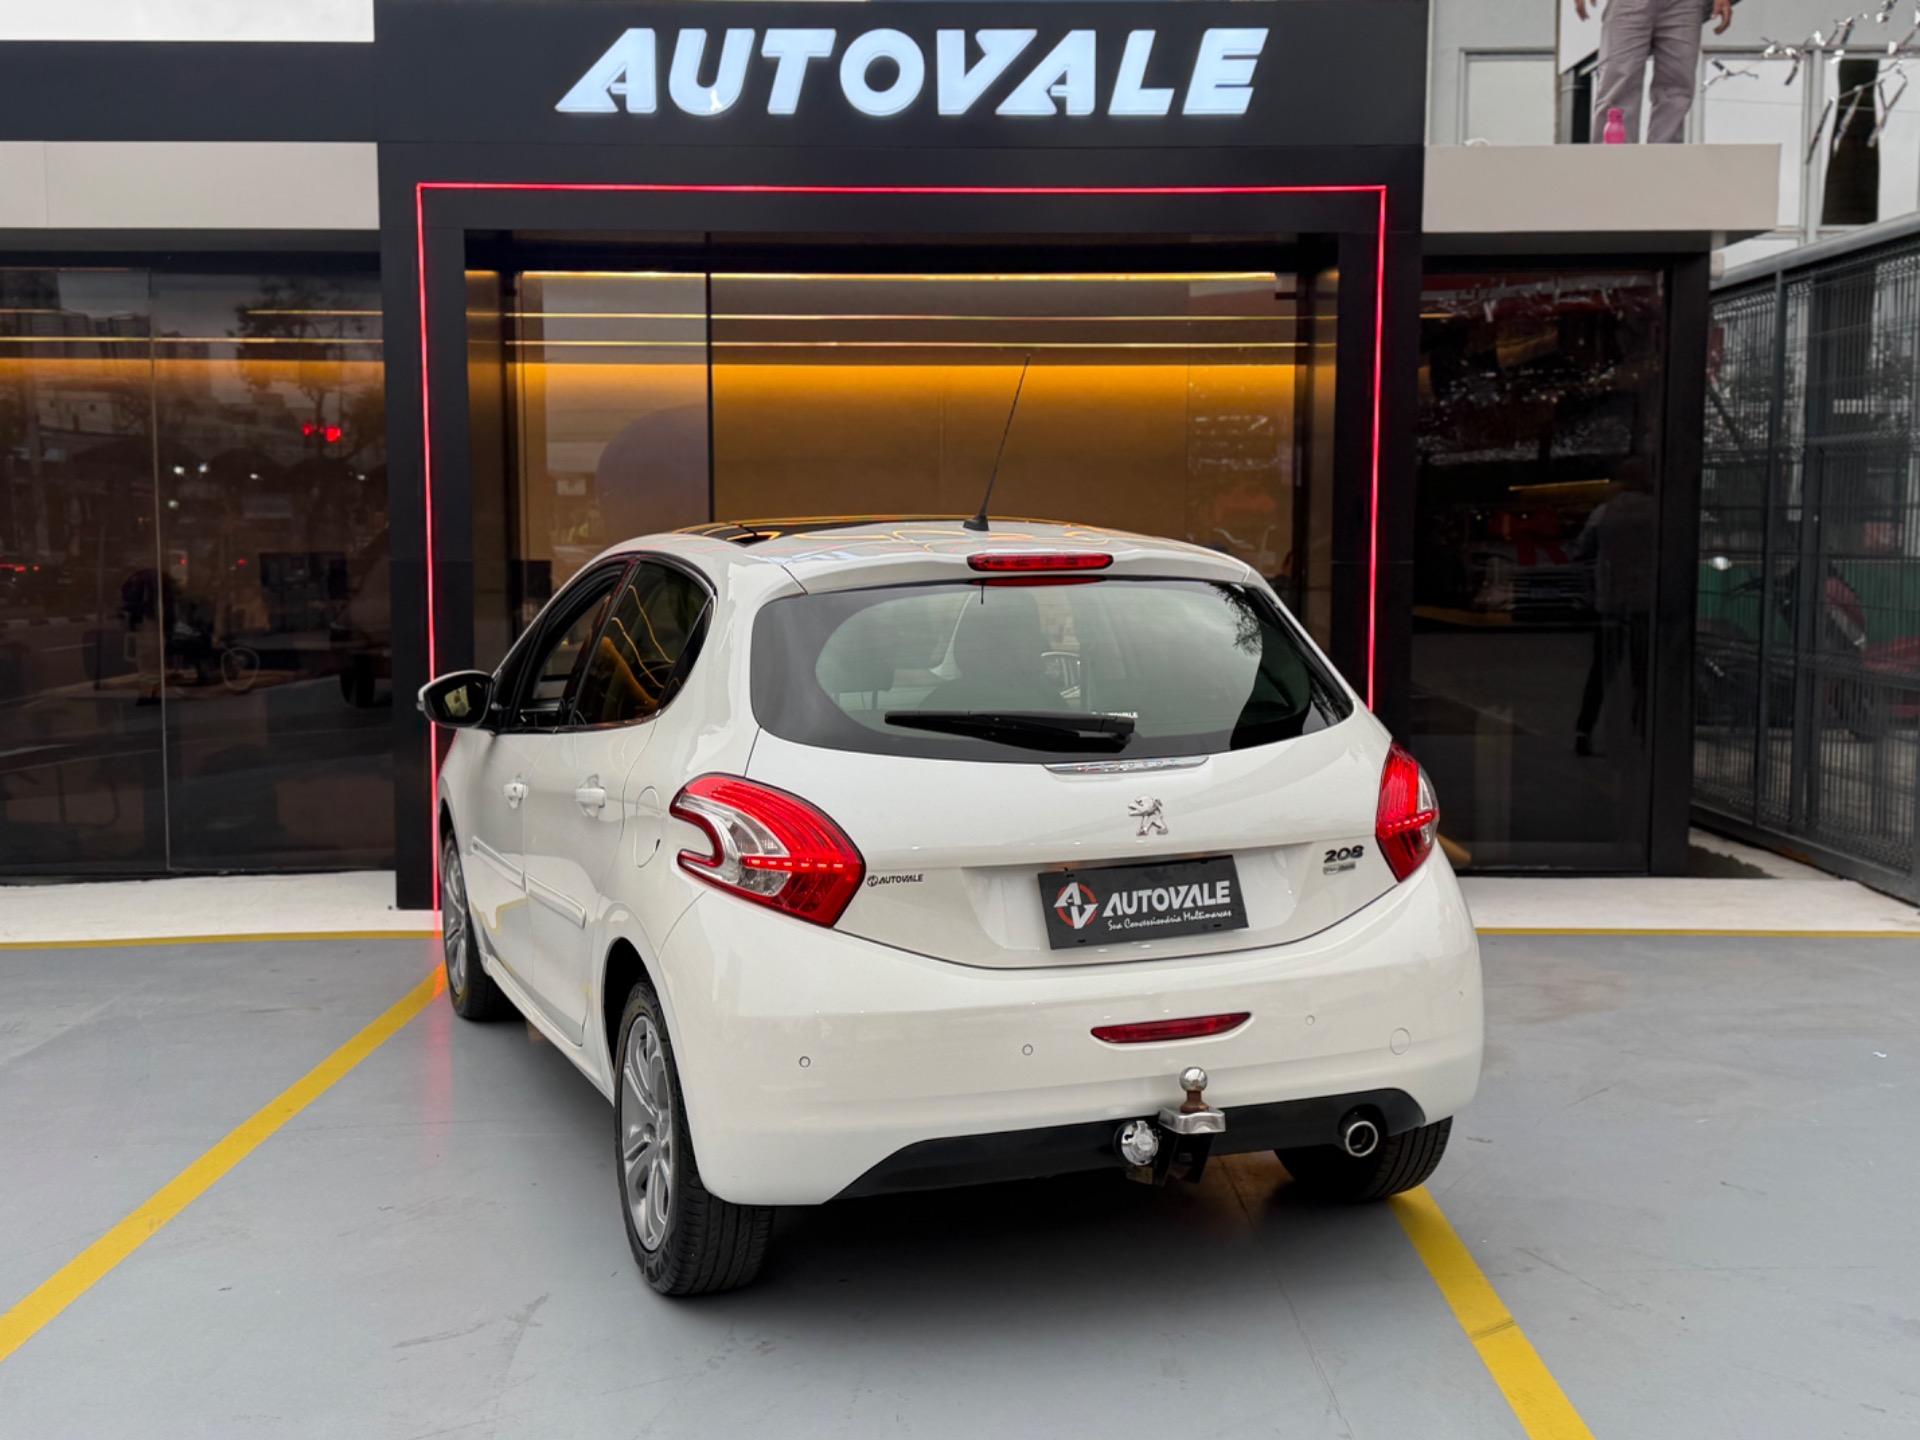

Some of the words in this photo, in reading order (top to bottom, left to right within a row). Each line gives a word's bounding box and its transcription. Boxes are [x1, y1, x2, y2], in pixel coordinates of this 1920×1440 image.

[555, 27, 1270, 116] AUTOVALE
[1323, 845, 1365, 864] 208
[879, 873, 924, 885] AUTOVALE
[1102, 880, 1231, 918] AUTOVALE
[1107, 919, 1123, 931] Sua
